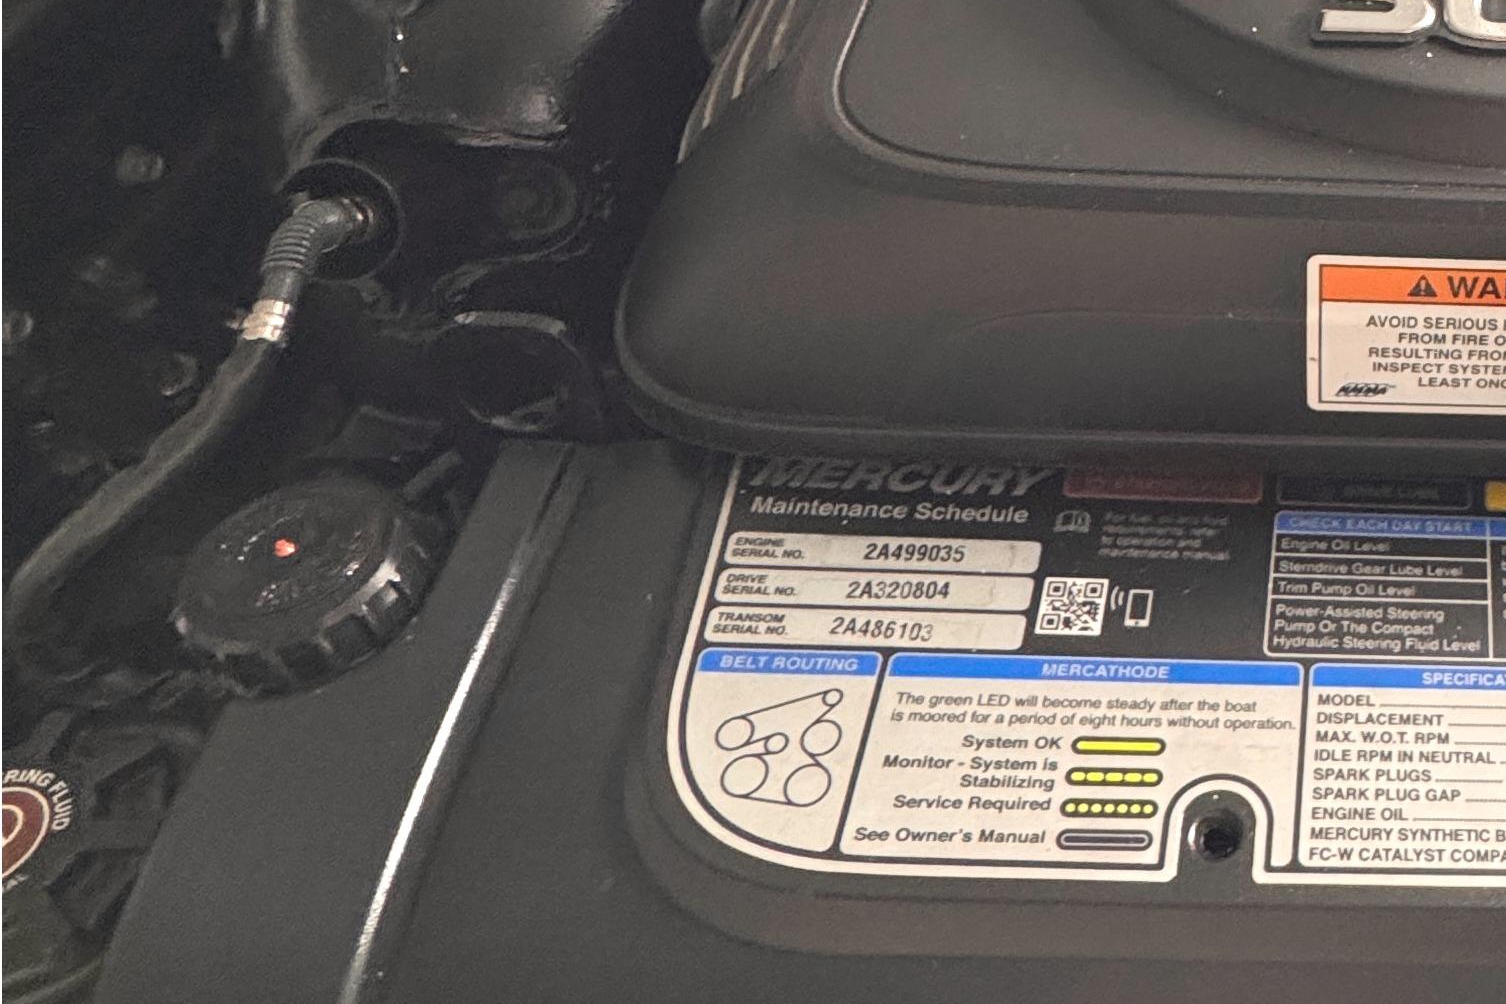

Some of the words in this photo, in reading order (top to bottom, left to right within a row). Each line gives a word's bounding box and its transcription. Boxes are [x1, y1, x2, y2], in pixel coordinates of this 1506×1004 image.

[1366, 316, 1418, 328] AVOID
[1423, 317, 1498, 330] SERIOUS
[1398, 333, 1446, 344] FROM
[1452, 334, 1489, 345] FIRE
[1369, 347, 1462, 359] RESULTING
[1373, 362, 1444, 373] INSPECT
[1418, 377, 1471, 388] LEAST
[751, 458, 1049, 496] MERCURY
[751, 497, 907, 518] Maintenance
[914, 502, 1029, 524] Schedule
[735, 537, 784, 547] ENGINE
[732, 549, 778, 558] SERIAL
[782, 550, 804, 559] NO.
[864, 544, 966, 562] 2A499035
[726, 574, 768, 584] DRIVE
[722, 586, 769, 595] SERIAL
[774, 587, 797, 596] NO.
[846, 581, 950, 599] 2A320804
[1278, 582, 1307, 593] Trim
[1312, 583, 1351, 596] Pump
[1356, 584, 1374, 595] Oil
[1379, 585, 1416, 596] Level
[717, 612, 784, 622] TRANSOM
[1276, 604, 1383, 619] Power-Assisted
[1387, 608, 1445, 623] Steering
[713, 624, 761, 634] SERIAL
[765, 625, 787, 635] NO.
[829, 617, 933, 641] 2A486103
[1274, 619, 1315, 633] Pump
[1319, 621, 1337, 632] Or
[1342, 622, 1367, 633] The
[1372, 623, 1434, 635] Compact
[1273, 636, 1339, 649] Hydraulic
[1343, 637, 1400, 652] Steering
[1406, 638, 1439, 650] Fluid
[1443, 639, 1480, 651] Level
[719, 656, 766, 668] BELT
[773, 657, 858, 671] ROUTING
[1041, 663, 1171, 679] MERCATHODE
[897, 692, 924, 704] The
[929, 695, 972, 708] green
[977, 695, 1009, 706] LED
[1015, 696, 1037, 707] will
[1042, 696, 1101, 709] become
[1106, 698, 1156, 712] steady
[1160, 699, 1193, 710] after
[1197, 700, 1220, 711] the
[1224, 700, 1256, 713] boat
[1317, 694, 1375, 706] MODEL
[891, 709, 903, 721] is
[908, 710, 966, 723] moored
[971, 711, 991, 722] for
[994, 714, 1004, 723] a
[1008, 712, 1056, 726] period
[1060, 713, 1076, 724] of
[1079, 713, 1116, 728] eight
[1120, 715, 1162, 727] hours
[1167, 716, 1219, 728] without
[1224, 717, 1295, 731] operation.
[1317, 712, 1444, 726] DISPLACEMENT
[962, 735, 1028, 751] System
[1034, 737, 1063, 749] OK
[1315, 731, 1355, 743] MAX.
[1360, 732, 1409, 744] W.O.T.
[1415, 733, 1449, 744] RPM
[883, 755, 954, 769] Monitor
[970, 757, 1037, 772] System
[1043, 758, 1058, 771] is
[1314, 750, 1351, 761] IDLE
[1357, 750, 1392, 762] RPM
[1398, 751, 1413, 762] IN
[1419, 751, 1495, 764] NEUTRAL
[1313, 768, 1370, 781] SPARK
[1375, 769, 1431, 782] PLUGS
[960, 774, 1055, 792] Stabilizing
[2, 769, 56, 787] RING
[48, 780, 74, 831] FLUID
[1313, 788, 1369, 800] SPARK
[1374, 788, 1420, 801] PLUG
[1425, 789, 1461, 801] GAP
[893, 795, 962, 809] Service
[968, 797, 1051, 813] Required
[1311, 807, 1375, 820] ENGINE
[1381, 808, 1408, 821] OIL
[854, 827, 889, 841] See
[895, 828, 973, 842] Owner's
[978, 829, 1046, 843] Manual
[1310, 827, 1393, 840] MERCURY
[1398, 828, 1490, 842] SYNTHETIC
[1309, 847, 1353, 861] FC-W
[1358, 848, 1446, 862] CATALYST
